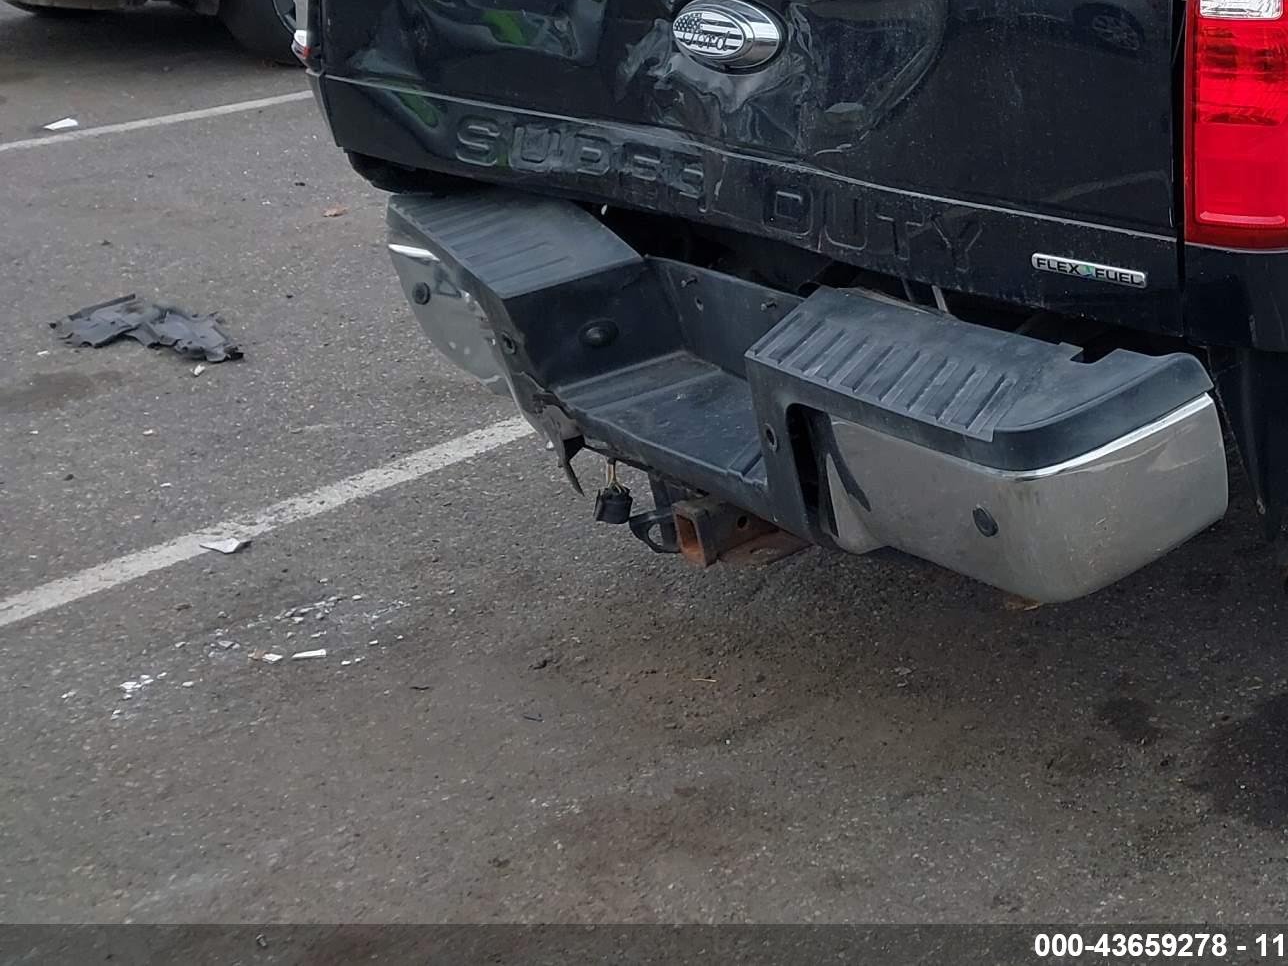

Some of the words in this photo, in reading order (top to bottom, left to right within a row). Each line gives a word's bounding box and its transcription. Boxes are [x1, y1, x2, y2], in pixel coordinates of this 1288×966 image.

[761, 184, 985, 274] DUTY
[1036, 257, 1080, 275] FLEX
[1094, 267, 1144, 286] FUEL
